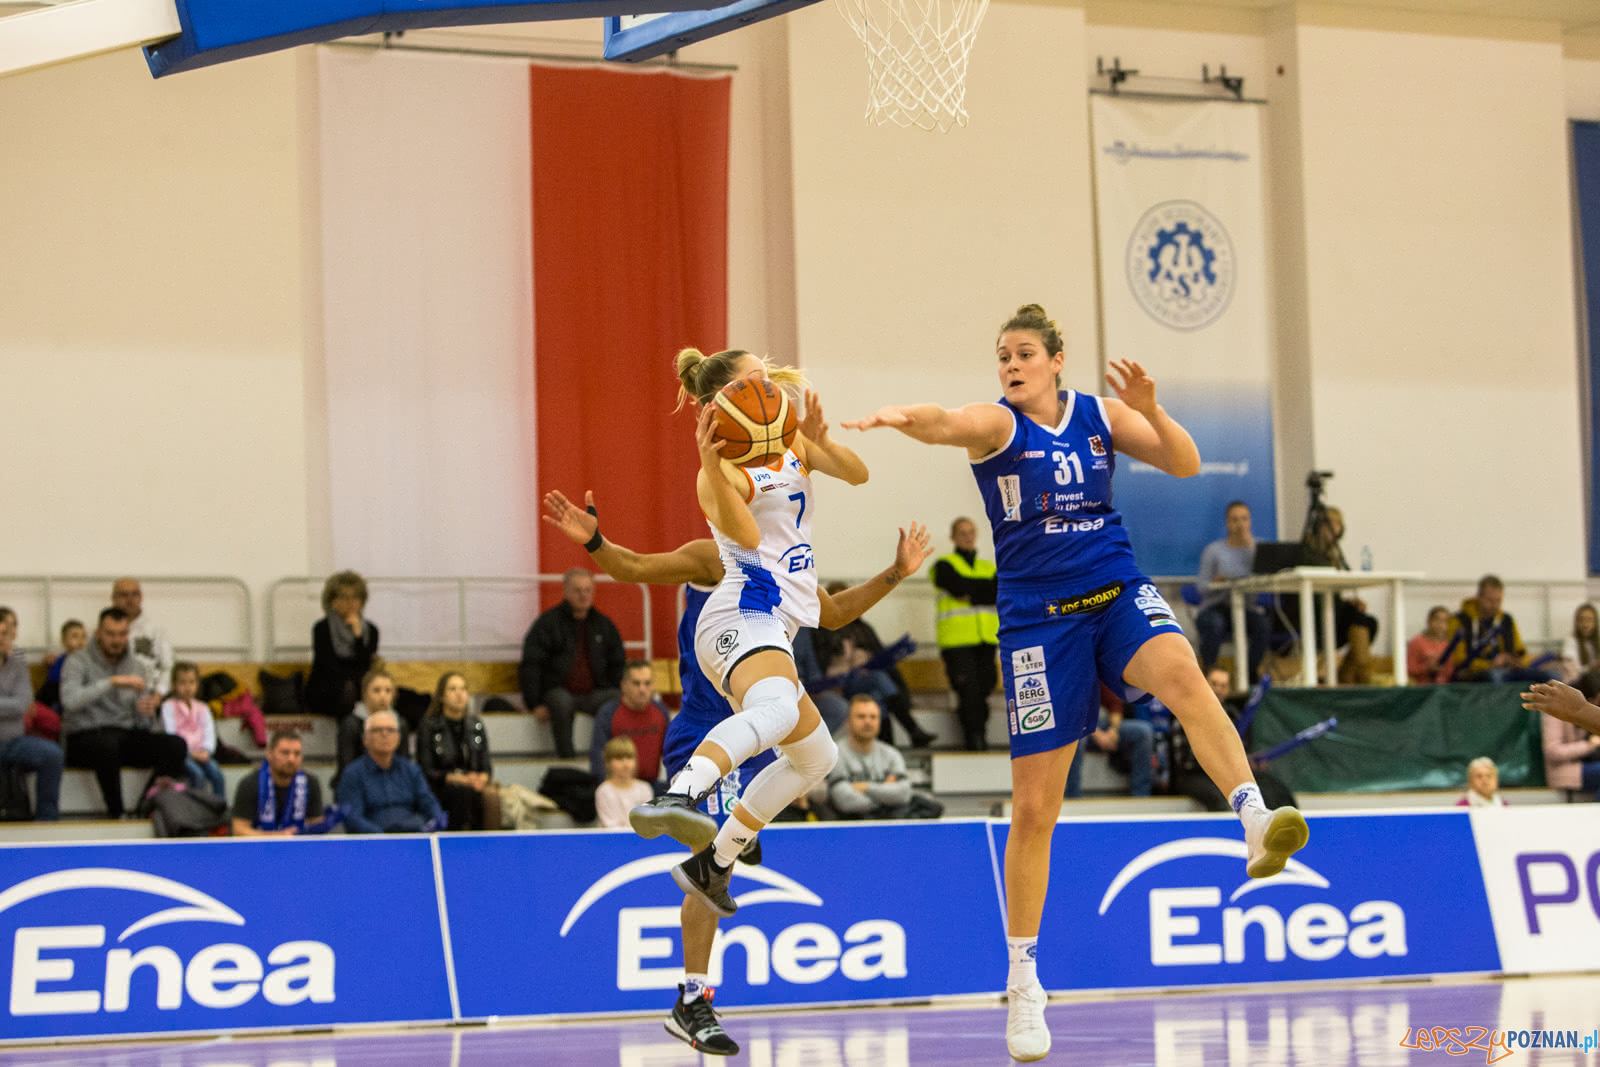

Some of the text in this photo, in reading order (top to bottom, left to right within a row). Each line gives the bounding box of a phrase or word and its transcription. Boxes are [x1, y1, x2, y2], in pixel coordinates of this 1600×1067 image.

[1051, 451, 1085, 486] 31
[787, 491, 806, 529] 7
[1055, 491, 1084, 502] Invest
[1065, 502, 1081, 512] the
[1044, 517, 1105, 535] Enea
[1018, 687, 1046, 701] BERG
[1515, 849, 1600, 935] P
[1148, 885, 1408, 967] Enea
[617, 905, 908, 991] Enea
[9, 924, 337, 1017] Enea
